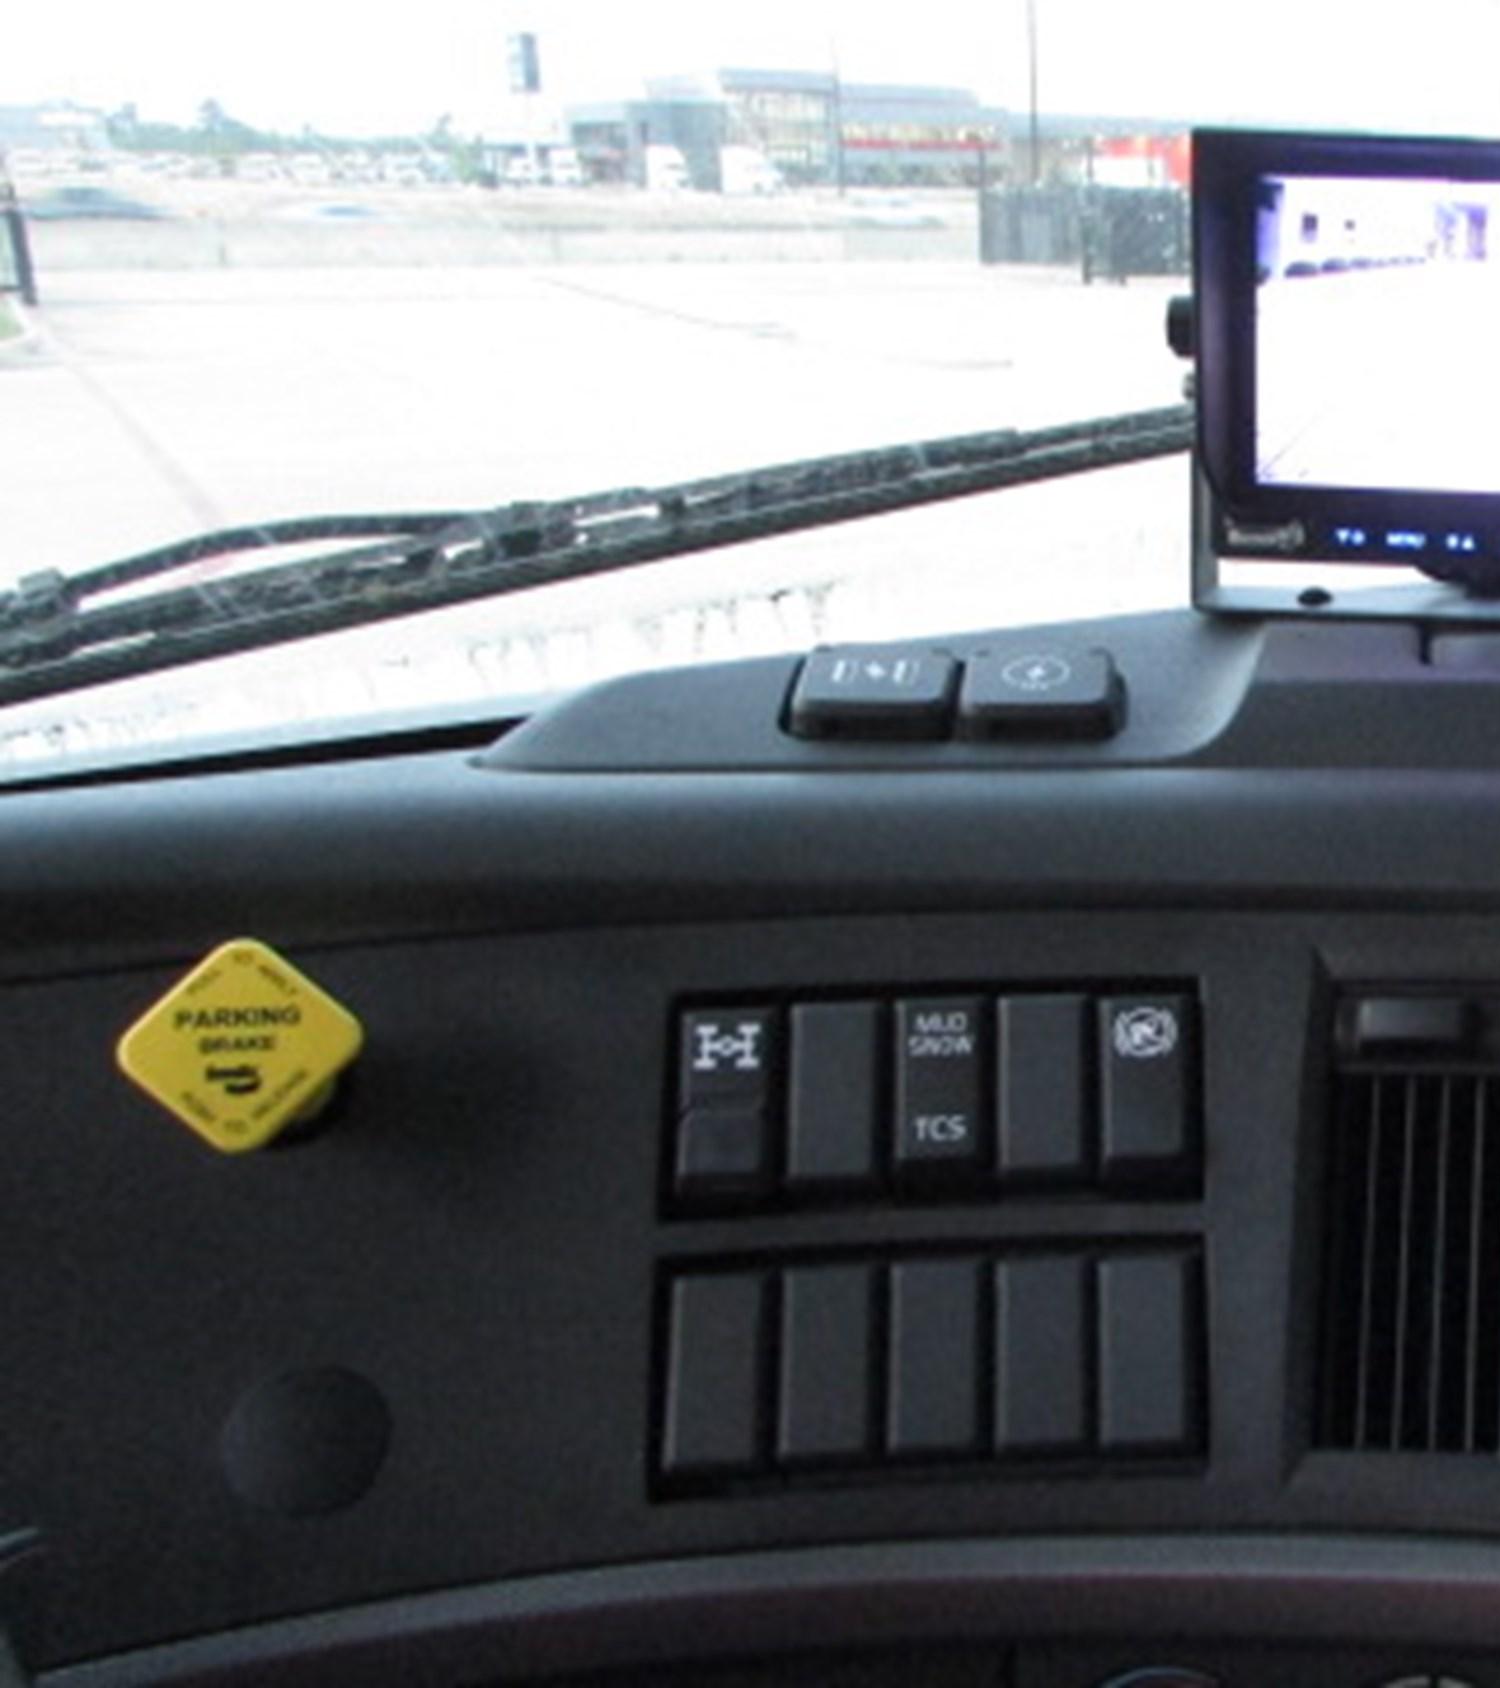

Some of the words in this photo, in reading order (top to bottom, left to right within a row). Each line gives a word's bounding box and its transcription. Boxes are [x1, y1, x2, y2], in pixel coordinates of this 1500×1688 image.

[173, 1003, 301, 1031] PARKING
[915, 1011, 968, 1033] MUD
[199, 1034, 275, 1055] BRAKE
[908, 1034, 974, 1057] SNOW
[914, 1114, 968, 1142] TCS
